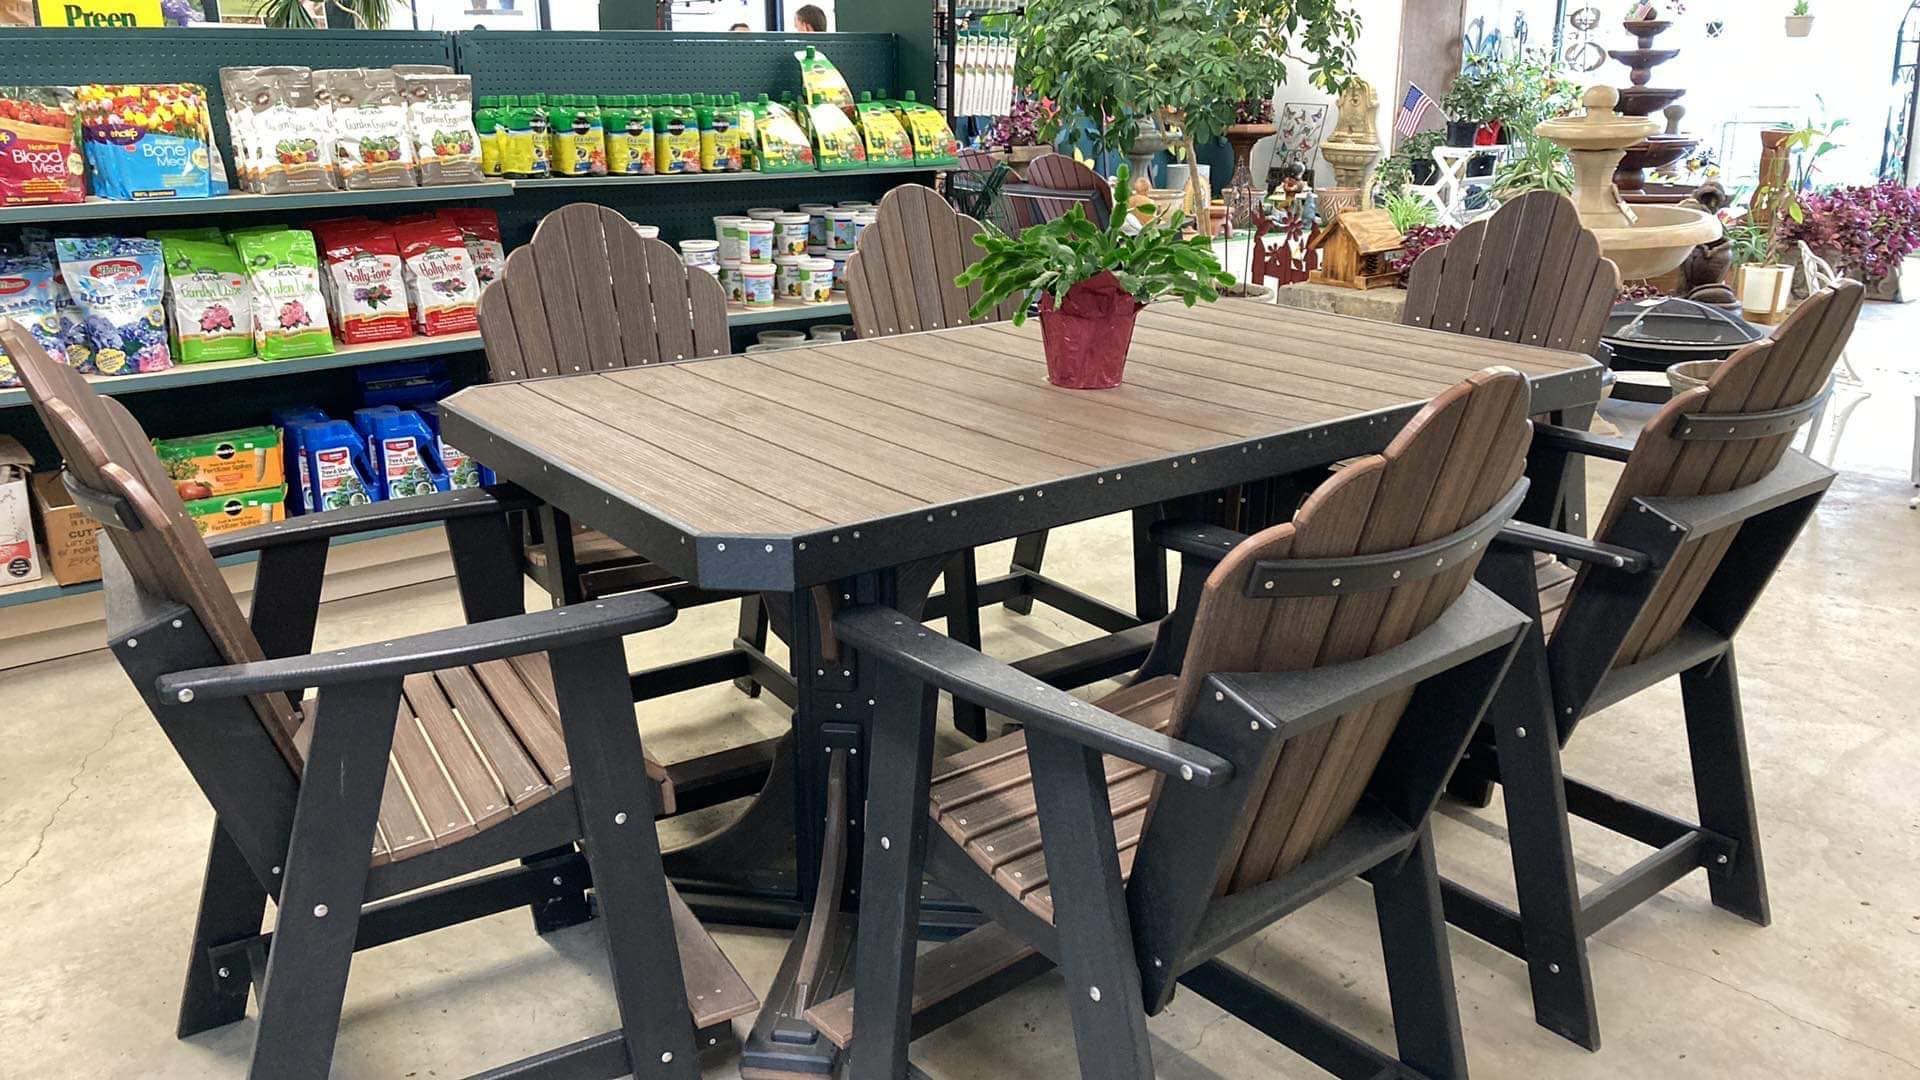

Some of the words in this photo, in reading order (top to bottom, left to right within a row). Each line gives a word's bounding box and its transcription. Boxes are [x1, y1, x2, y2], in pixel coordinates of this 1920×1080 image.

[64, 4, 137, 27] Preen
[12, 147, 63, 164] Blood
[143, 143, 187, 157] Bone
[345, 268, 392, 285] Holly-tone
[419, 262, 463, 278] Holly-tone
[69, 528, 93, 539] CUT
